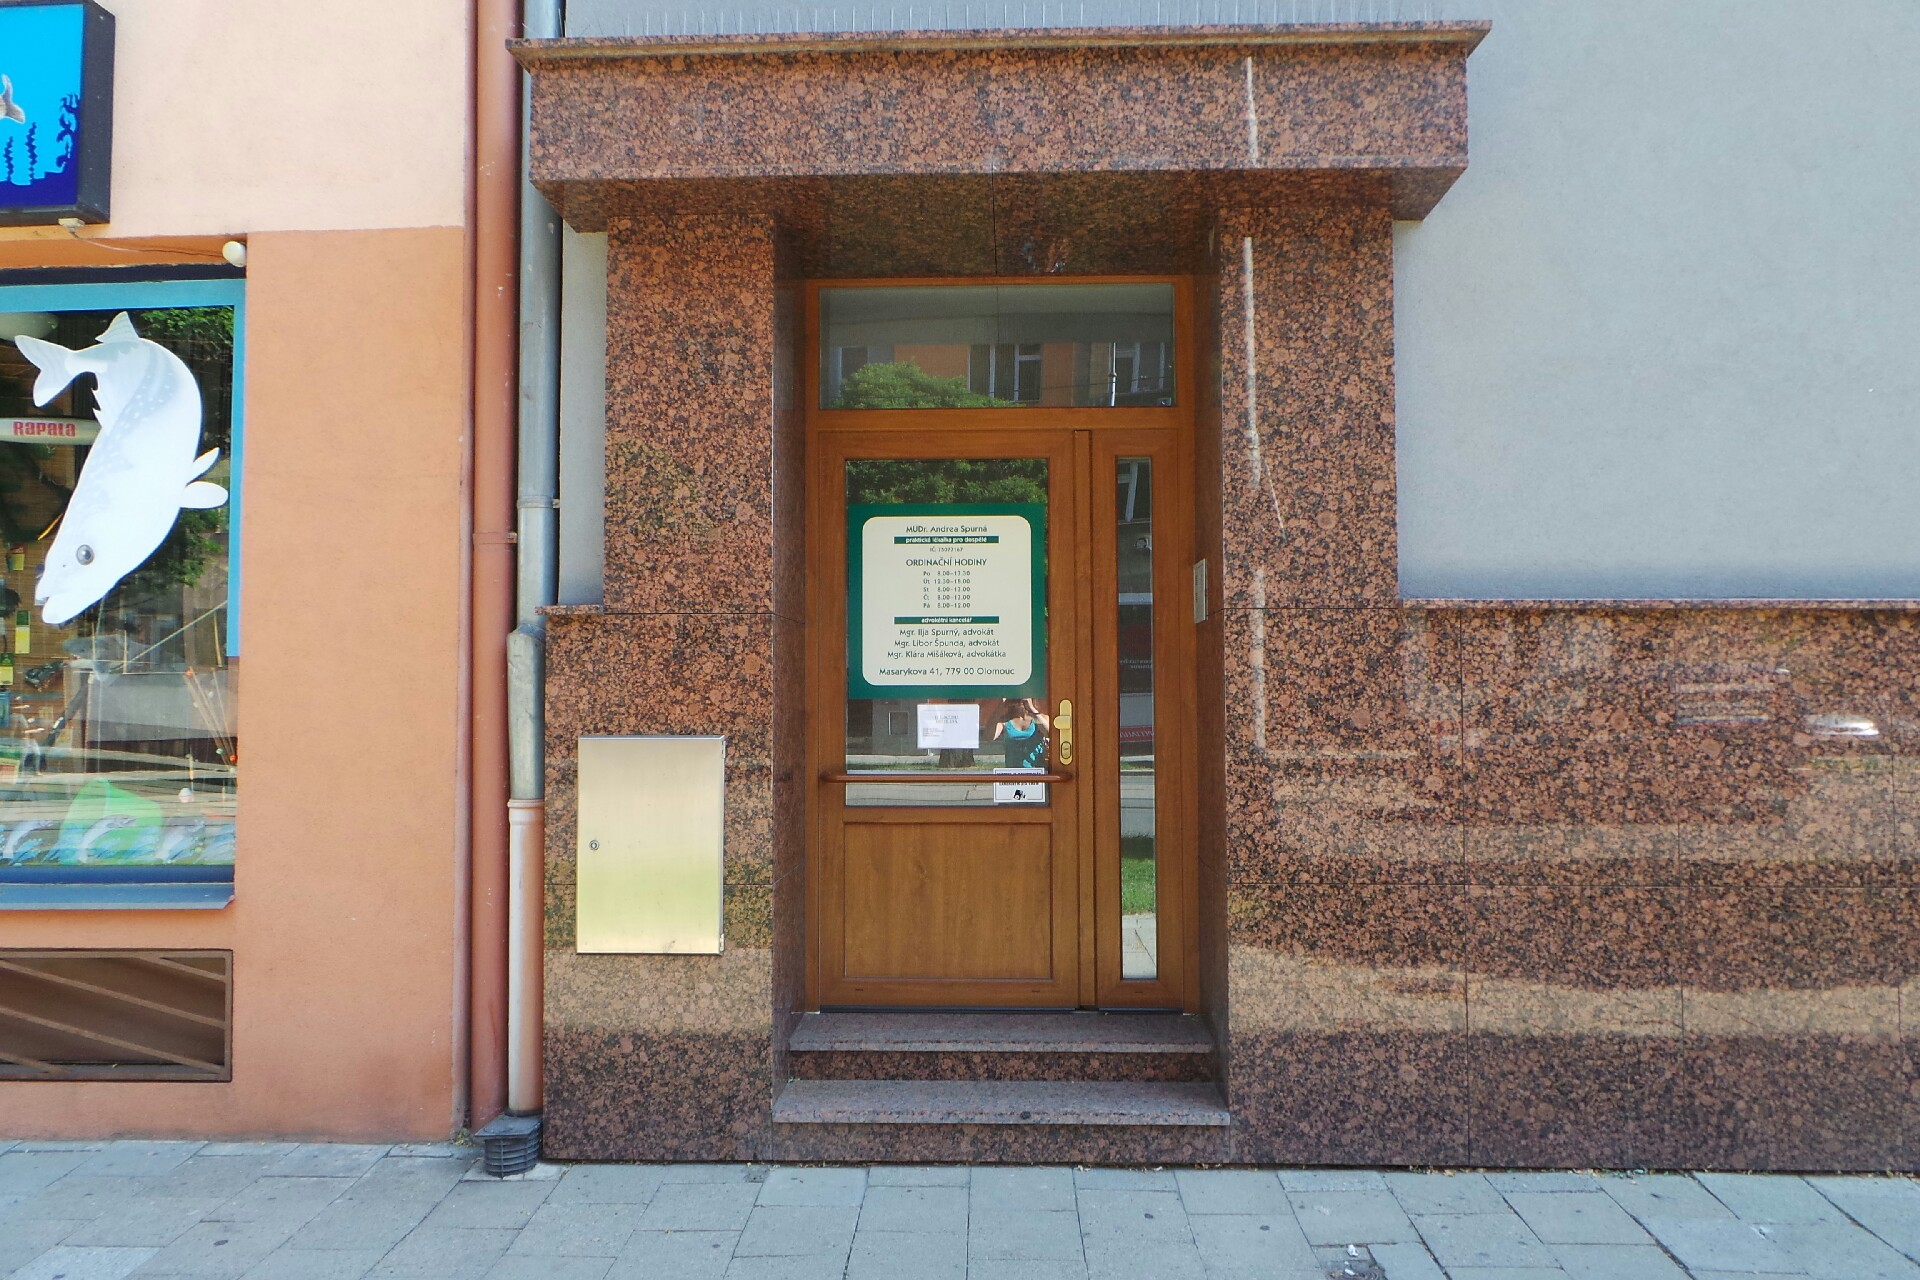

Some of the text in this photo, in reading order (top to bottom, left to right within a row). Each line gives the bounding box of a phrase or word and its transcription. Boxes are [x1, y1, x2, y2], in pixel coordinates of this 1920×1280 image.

[906, 525, 988, 534] MUDr. Andrea Spurná
[906, 556, 987, 566] ORDINAČNÍ HODINY
[900, 629, 915, 637] Mgr.
[931, 628, 960, 637] Spurný,
[894, 640, 910, 648] Mgr.
[887, 651, 903, 659] Mgr.
[879, 668, 927, 676] Masarykova
[929, 668, 943, 676] 41,
